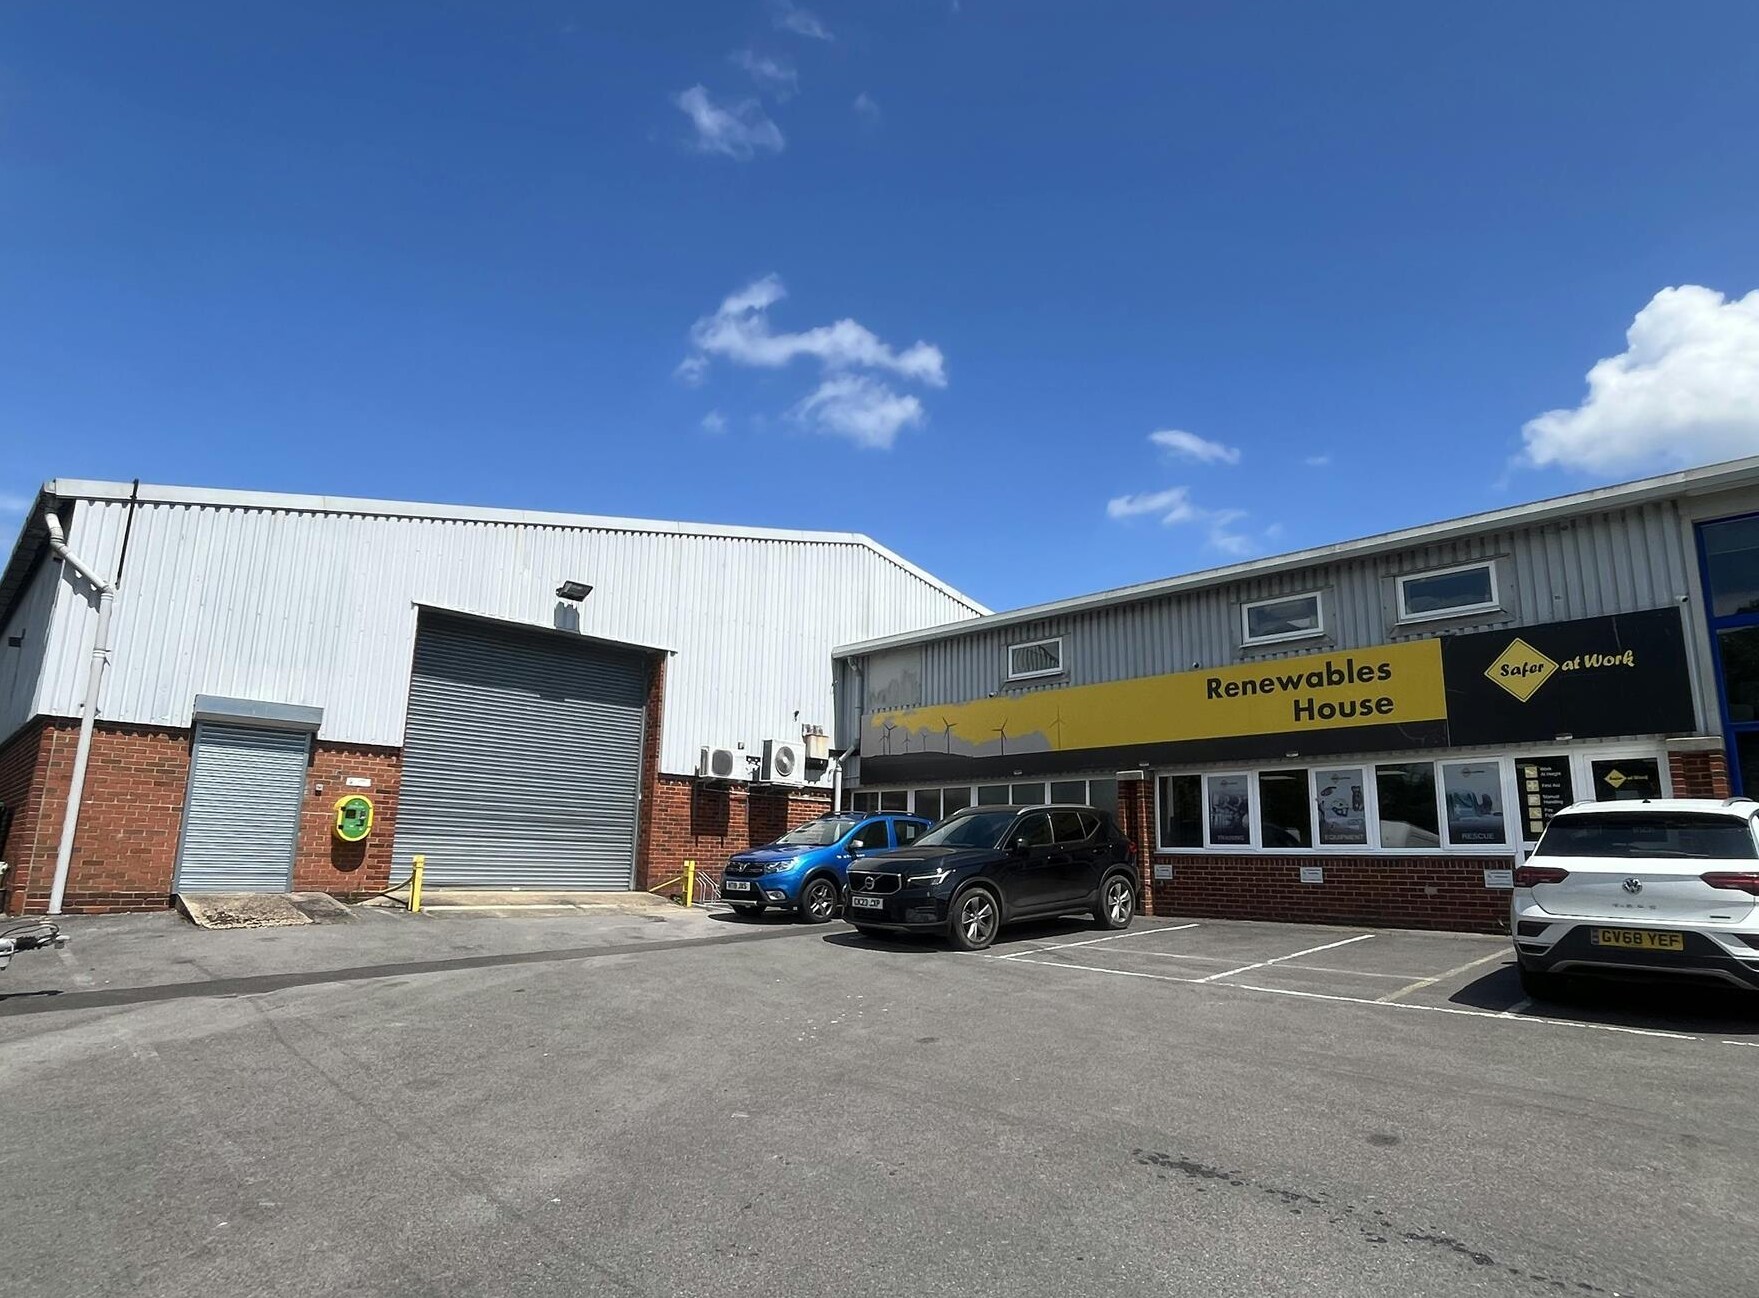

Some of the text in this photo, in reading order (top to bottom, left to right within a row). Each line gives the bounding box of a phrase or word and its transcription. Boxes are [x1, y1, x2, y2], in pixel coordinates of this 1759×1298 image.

[1500, 650, 1635, 677] Safer at Work
[1207, 658, 1392, 699] Renewables
[1294, 697, 1394, 722] House
[1461, 832, 1496, 840] RESCUE
[1601, 929, 1681, 947] GV68 YEF
